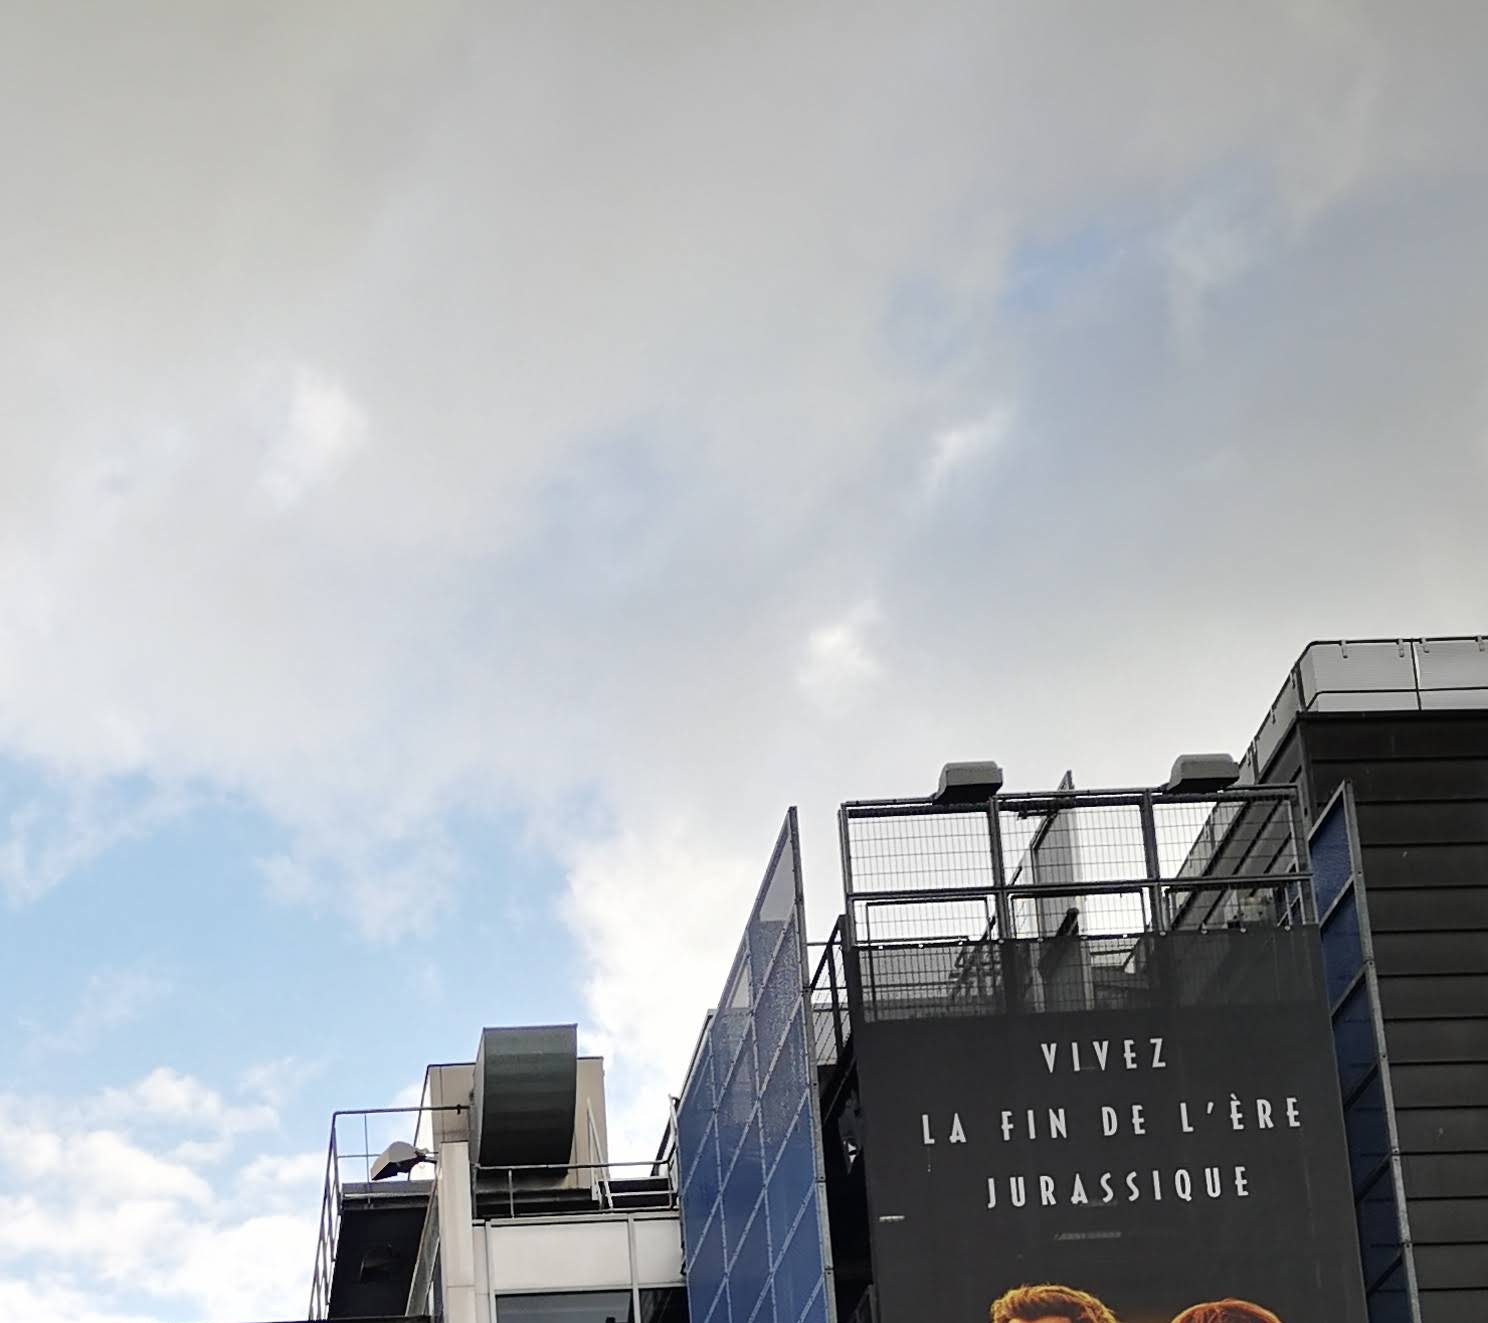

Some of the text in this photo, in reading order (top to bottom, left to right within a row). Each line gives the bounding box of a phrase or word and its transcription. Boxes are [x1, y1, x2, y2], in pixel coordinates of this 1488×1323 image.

[1040, 1037, 1166, 1073] VIVEZ
[922, 1093, 1301, 1145] LA FIN DE L'ÈRE
[987, 1166, 1249, 1209] JURASSIQUE
